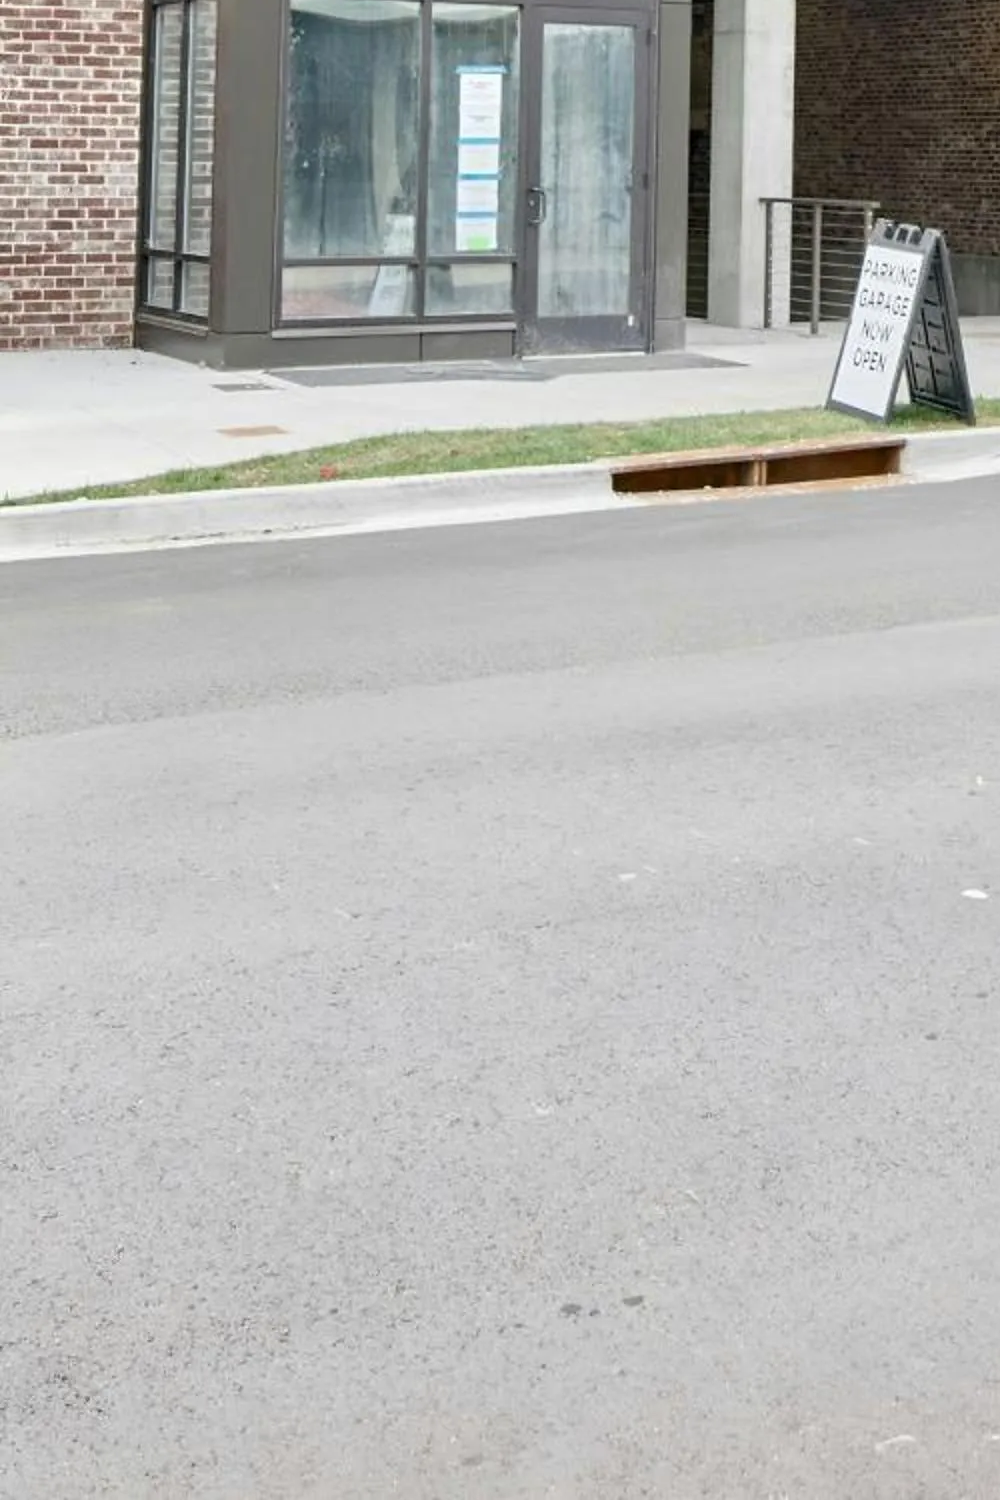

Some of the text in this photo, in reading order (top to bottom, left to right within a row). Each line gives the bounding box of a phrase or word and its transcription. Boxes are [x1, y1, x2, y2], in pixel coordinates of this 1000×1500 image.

[863, 260, 917, 288] PARKING
[859, 288, 910, 317] GARAGE
[862, 319, 893, 342] NOW
[853, 347, 886, 372] OPEN
